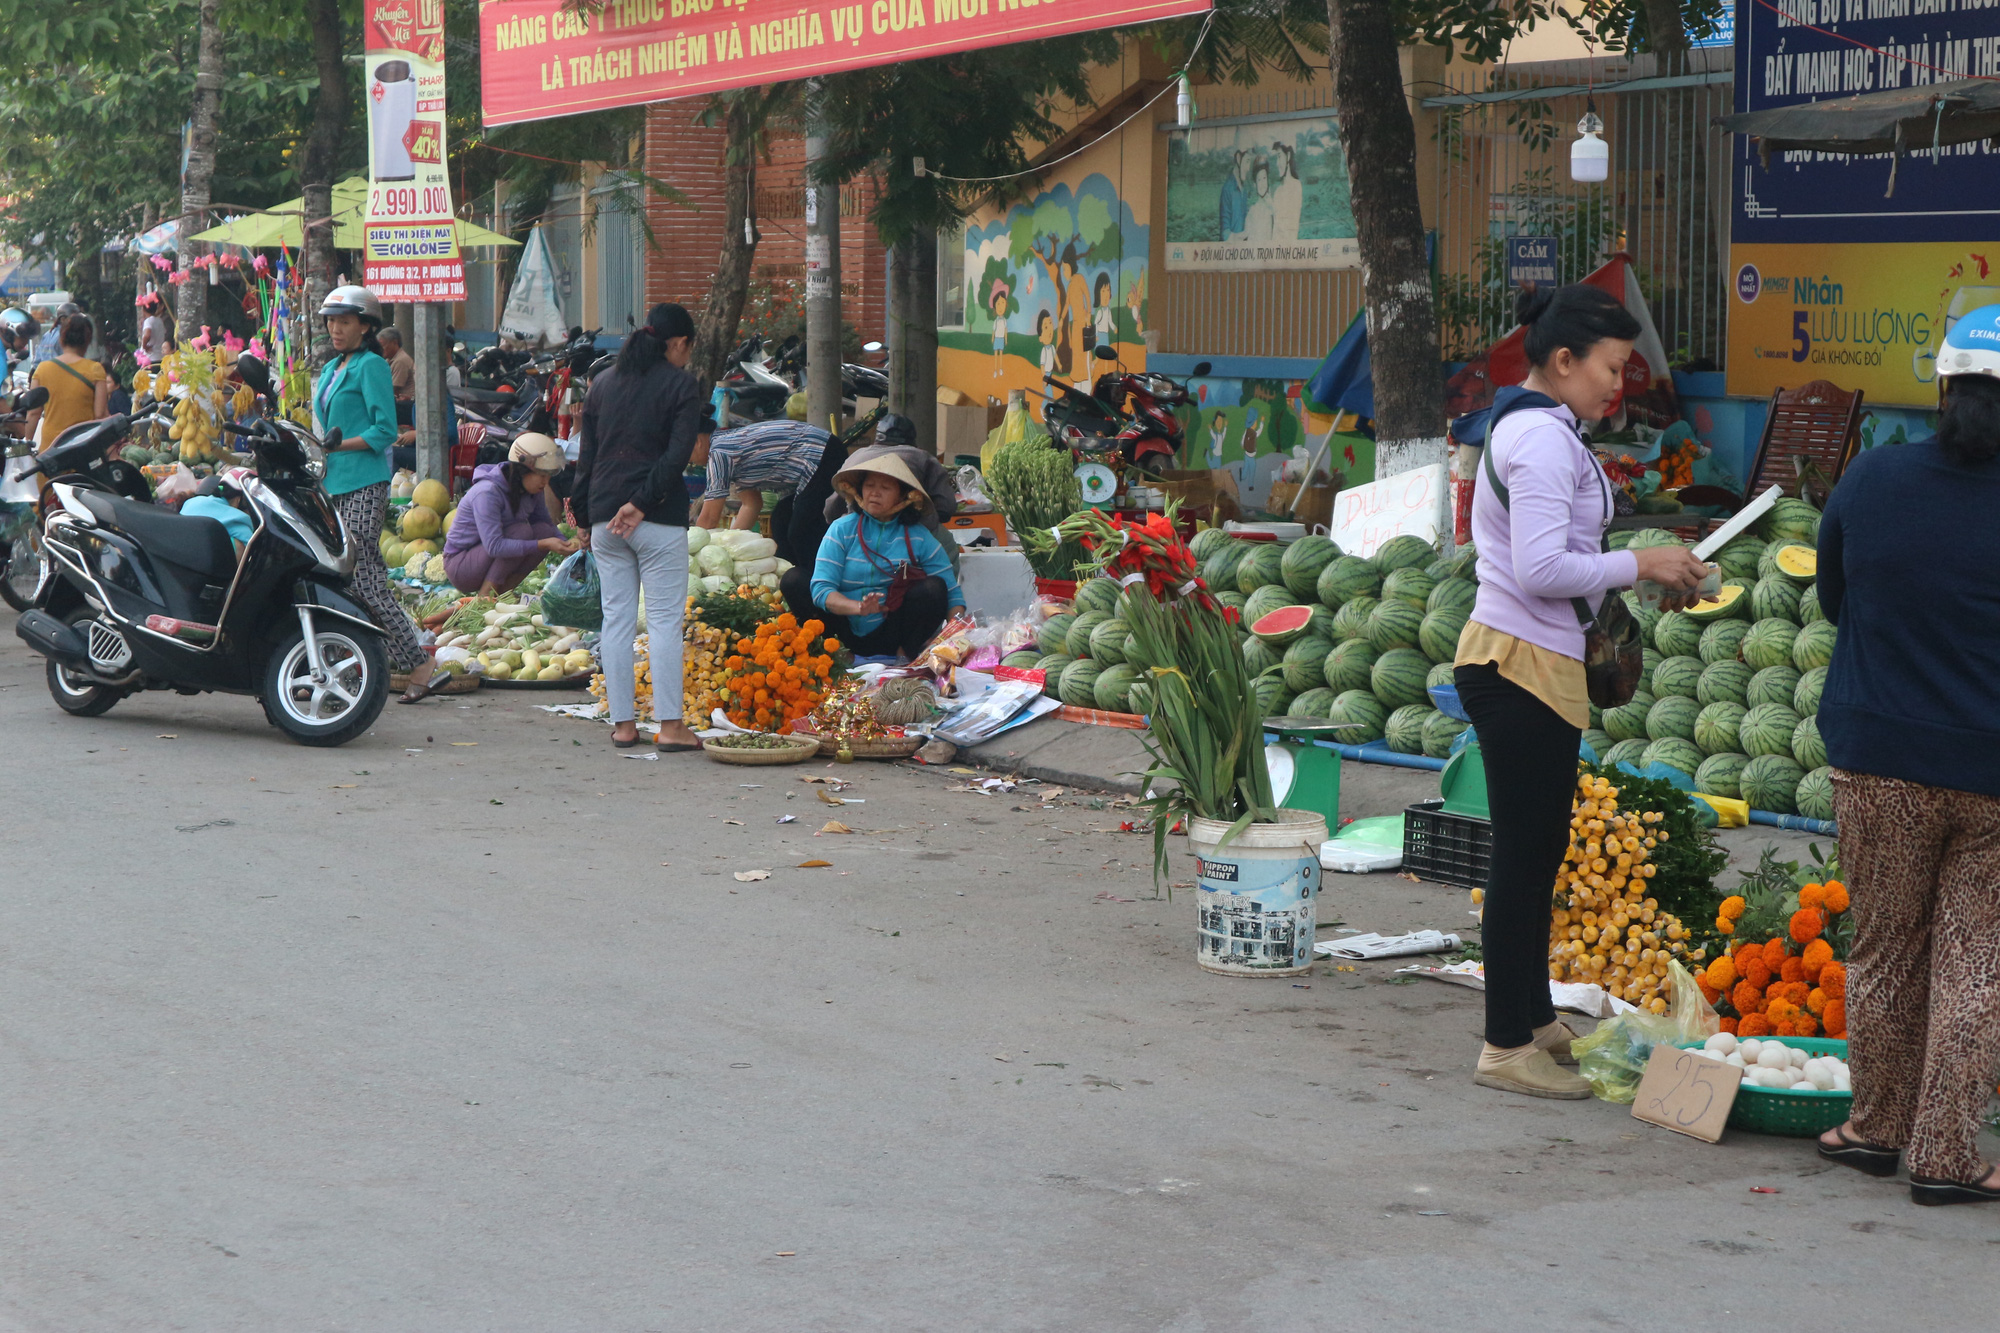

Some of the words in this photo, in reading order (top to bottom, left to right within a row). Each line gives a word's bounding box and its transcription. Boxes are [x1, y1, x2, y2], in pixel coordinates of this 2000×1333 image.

[496, 14, 547, 51] NÂNG
[552, 7, 589, 40] CAO
[542, 55, 564, 91] LÀ
[569, 46, 632, 87] TRÁCH
[638, 32, 708, 76] NHIỆM
[714, 22, 743, 62] VÀ
[750, 8, 824, 57] NGHĨA
[830, 4, 863, 46] VỤ
[1765, 37, 1793, 96] ĐẨY
[1796, 50, 1840, 103] MẠNH
[1911, 33, 1930, 87] VÀ
[1935, 31, 1968, 84] LÀM
[411, 135, 440, 159] 40%
[371, 186, 448, 216] 2.990.000
[1225, 248, 1239, 260] CHO
[366, 267, 379, 279] 161
[1794, 274, 1842, 305] Nhân
[1792, 311, 1810, 363] 5
[1813, 307, 1847, 342] LƯU
[1853, 308, 1930, 351] LƯỢNG
[1829, 348, 1862, 365] KHÔNG
[1206, 870, 1232, 880] PAINT
[1649, 1053, 1721, 1127] 25
